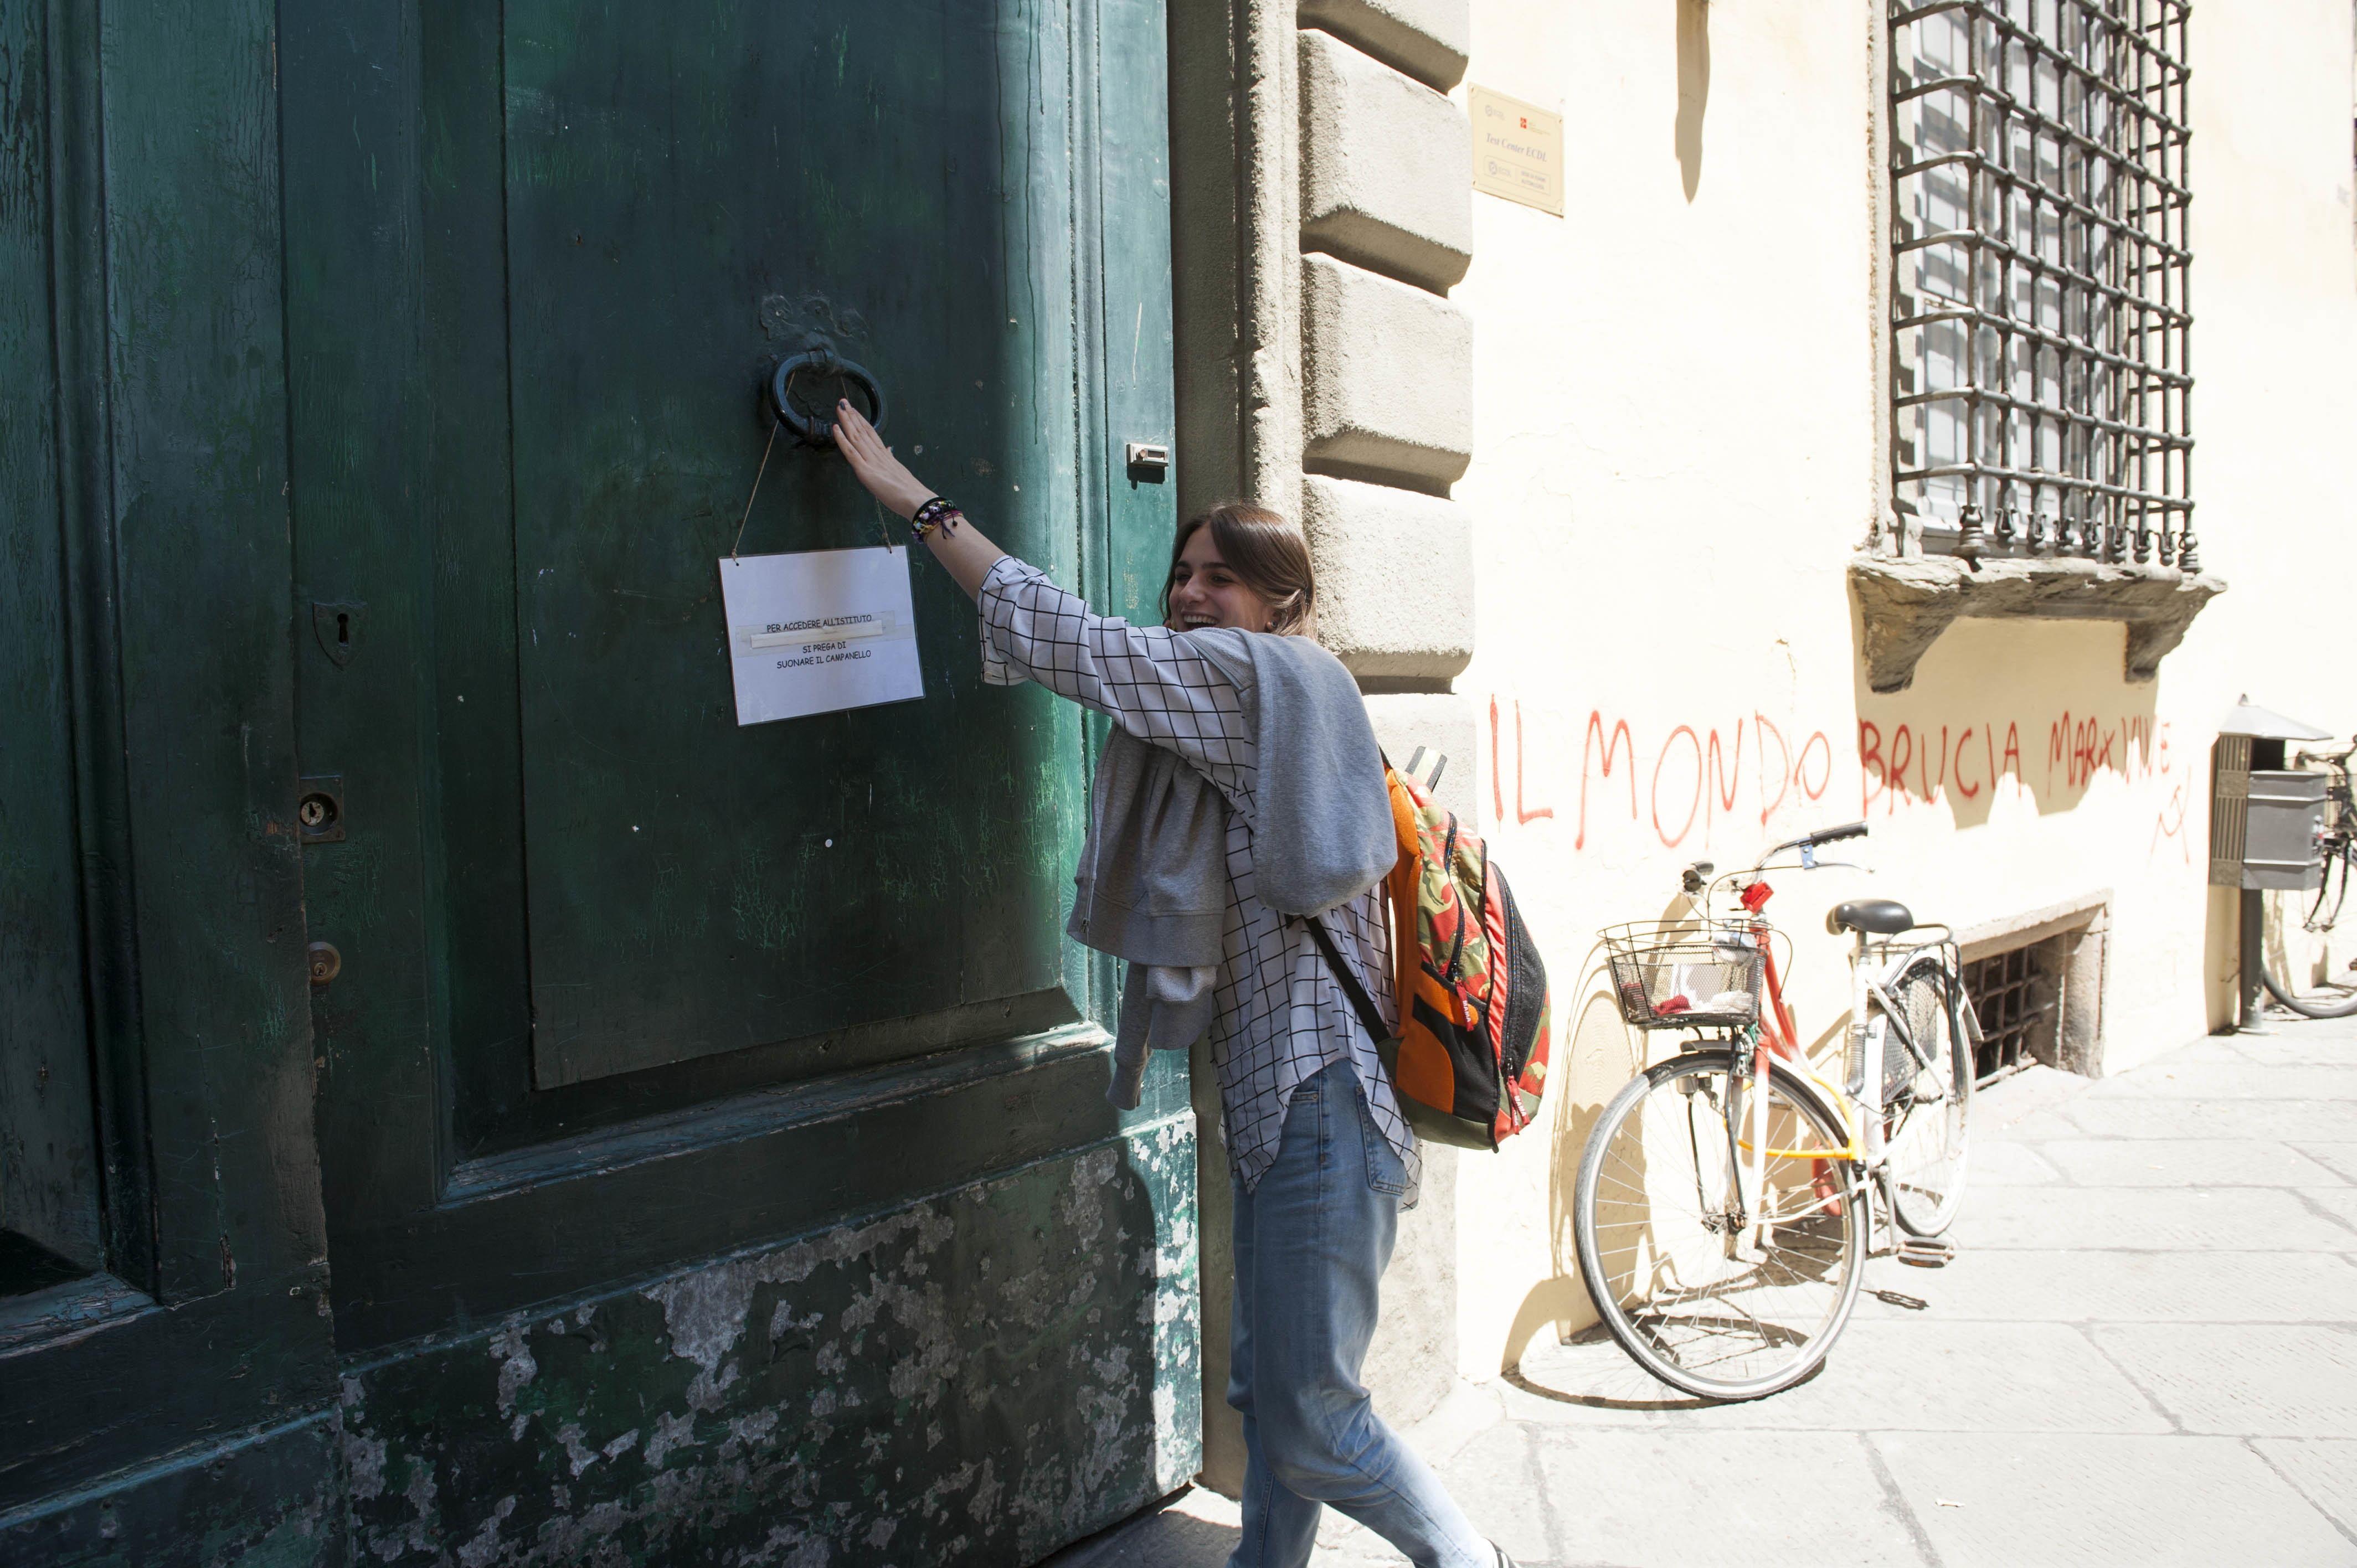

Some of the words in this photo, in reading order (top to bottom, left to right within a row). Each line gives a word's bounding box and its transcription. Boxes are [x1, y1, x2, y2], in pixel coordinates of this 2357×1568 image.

[1486, 133, 1500, 146] Test
[1501, 138, 1525, 154] Center
[1526, 146, 1547, 162] ECDL
[766, 624, 781, 633] PER
[783, 619, 821, 631] ACCEDERE
[823, 614, 872, 627] ALL'ISTITUTO
[802, 645, 811, 654] SI
[813, 642, 836, 652] PREGA
[837, 641, 846, 649] DI
[776, 657, 814, 669] SUONARE
[816, 656, 824, 664] IL
[826, 650, 872, 663] CAMPANELLO
[1489, 693, 1554, 831] IL
[1575, 709, 1831, 851] MONDO
[1857, 716, 2021, 819] BRUCIA
[1462, 1000, 1471, 1023] MAMA
[1514, 1095, 1527, 1117] MAMA
